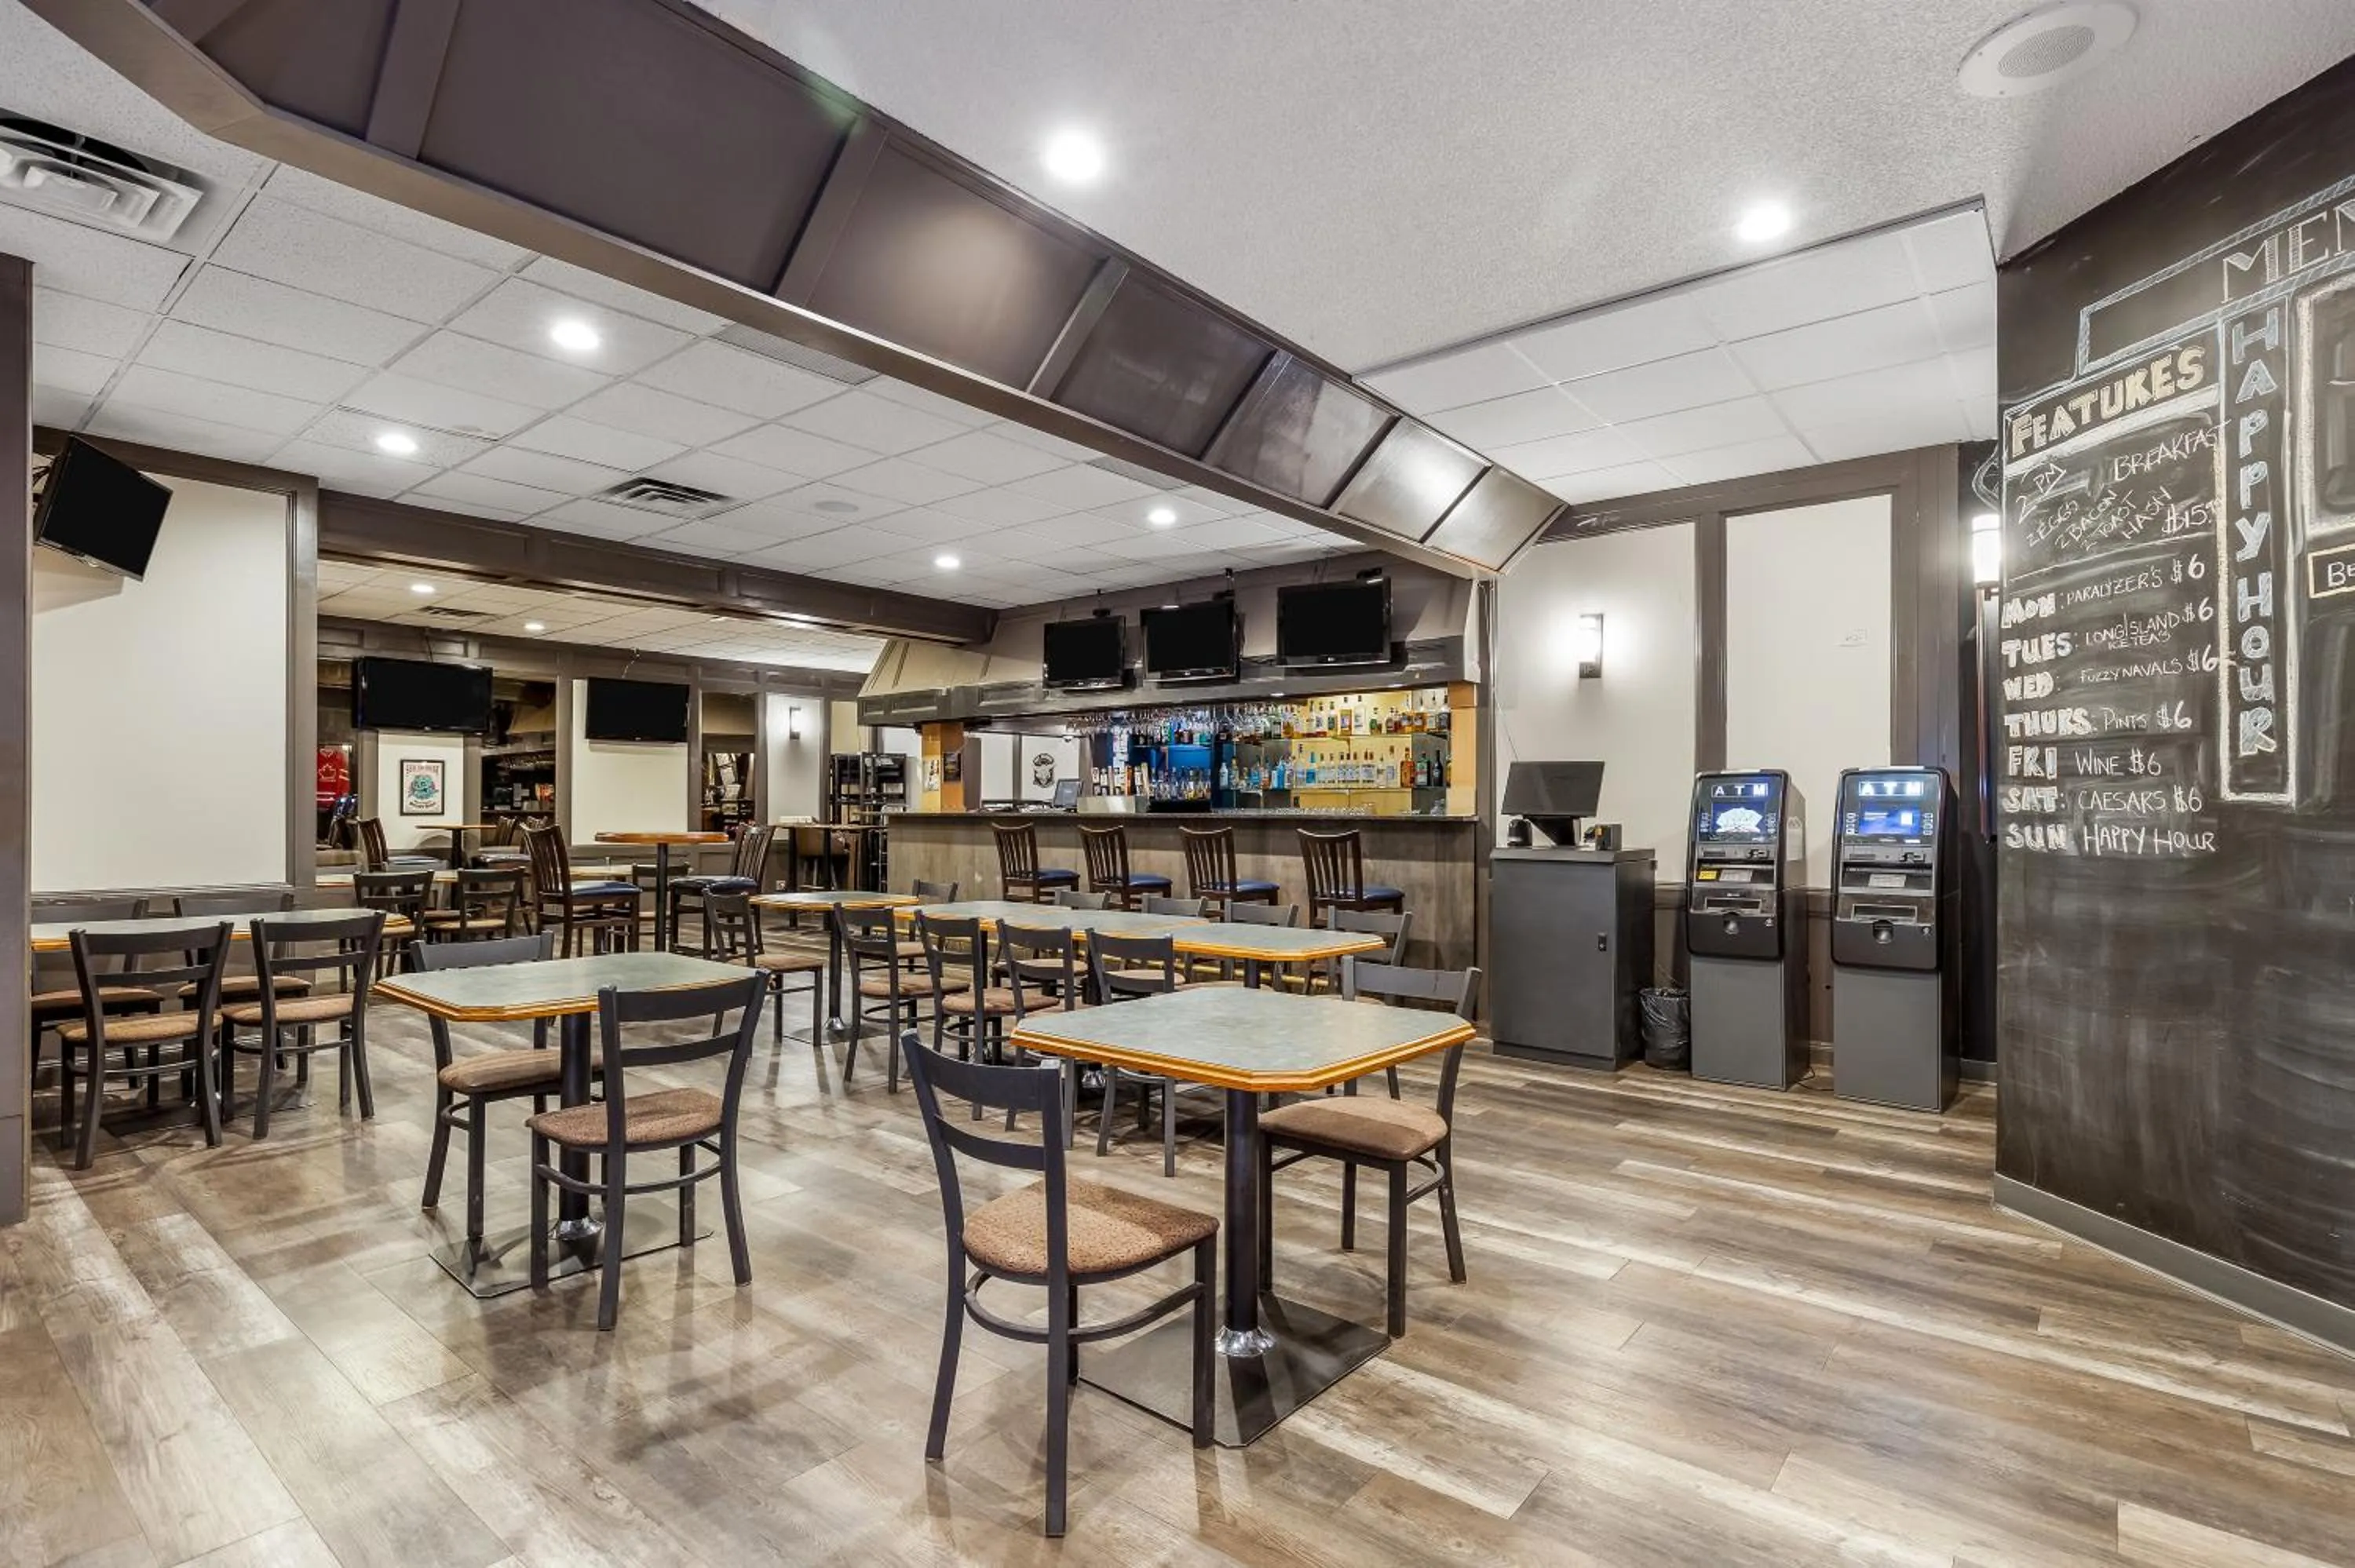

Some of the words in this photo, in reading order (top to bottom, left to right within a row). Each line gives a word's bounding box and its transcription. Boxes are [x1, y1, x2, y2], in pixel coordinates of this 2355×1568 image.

[2012, 346, 2205, 458] FEATURES
[2233, 307, 2277, 562] HAPPY
[2122, 485, 2172, 539] HASH
[2086, 624, 2124, 646] LONG
[2123, 611, 2180, 636] ISLAND
[2122, 658, 2183, 677] NAVALS
[2236, 571, 2277, 757] HOUR
[2156, 700, 2193, 729] $6
[2008, 746, 2058, 780] FRI
[2128, 747, 2162, 777] $6
[1713, 784, 1766, 796] ATM
[1860, 782, 1922, 796] ATM
[2078, 790, 2167, 814] CAESARS
[2173, 785, 2203, 813] $6
[2083, 823, 2146, 855] HAPPY
[2153, 828, 2216, 855] HOUR
